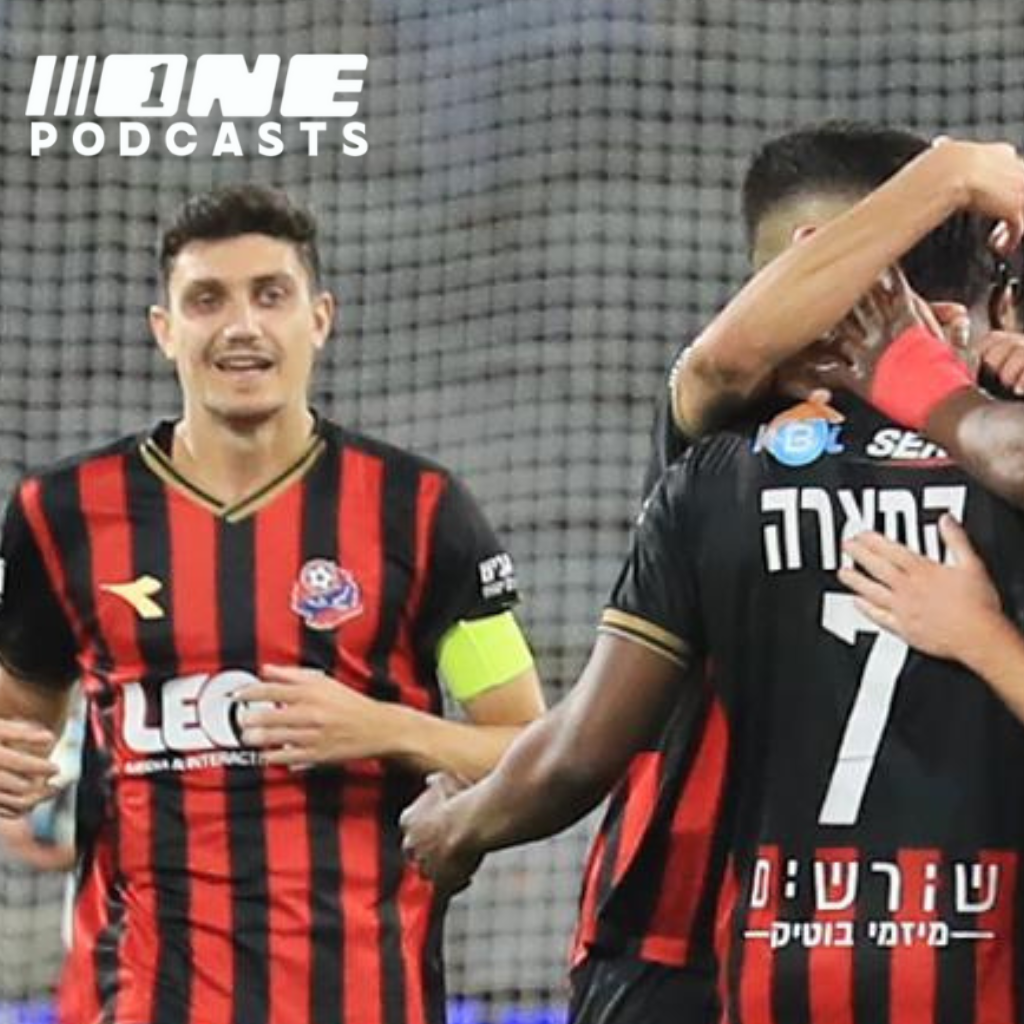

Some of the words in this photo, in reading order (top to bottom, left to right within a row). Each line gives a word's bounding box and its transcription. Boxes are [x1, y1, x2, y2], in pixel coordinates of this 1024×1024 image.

[866, 428, 949, 459] SE
[122, 669, 275, 753] LEO
[821, 592, 910, 825] 7
[751, 859, 998, 912] שורשים
[770, 920, 854, 949] בוטיק
[868, 920, 949, 947] מיזמי
